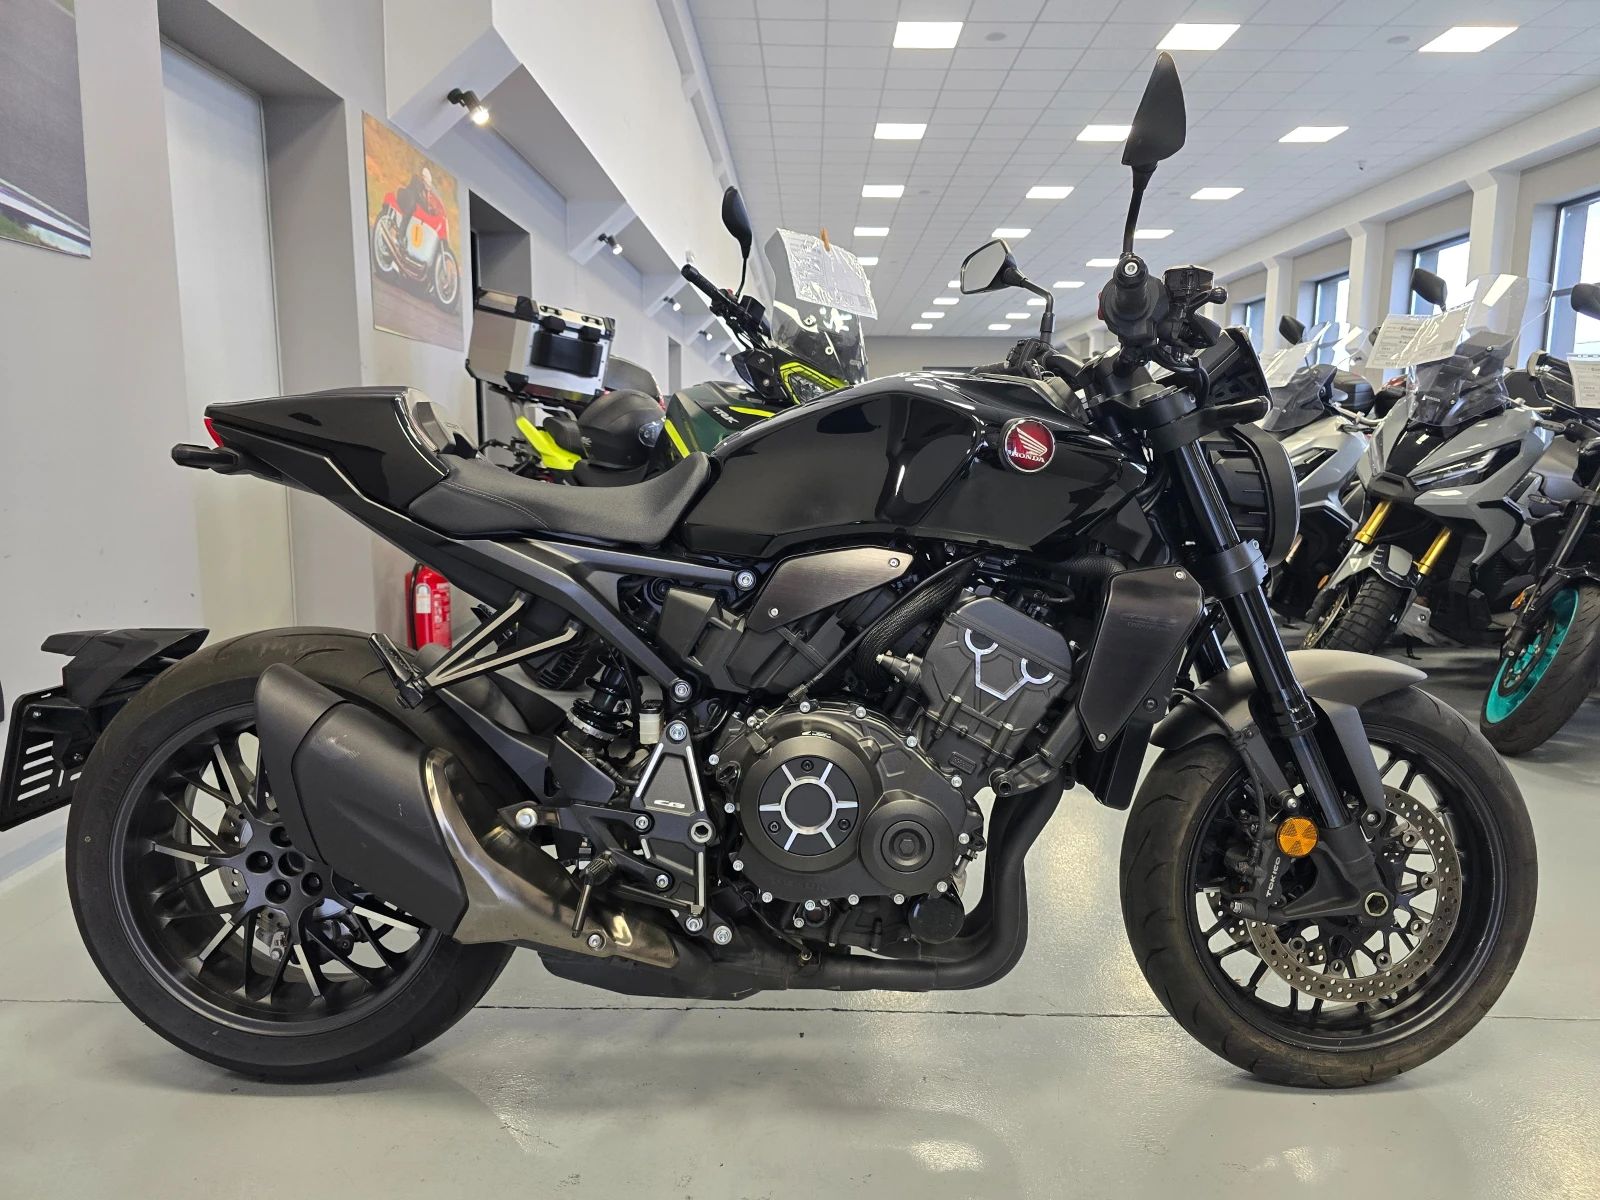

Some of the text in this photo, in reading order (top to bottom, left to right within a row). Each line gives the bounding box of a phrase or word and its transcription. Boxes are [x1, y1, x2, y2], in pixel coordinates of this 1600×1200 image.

[712, 406, 740, 424] TRK
[1010, 452, 1046, 463] HONDA
[1265, 856, 1281, 898] TOKICO
